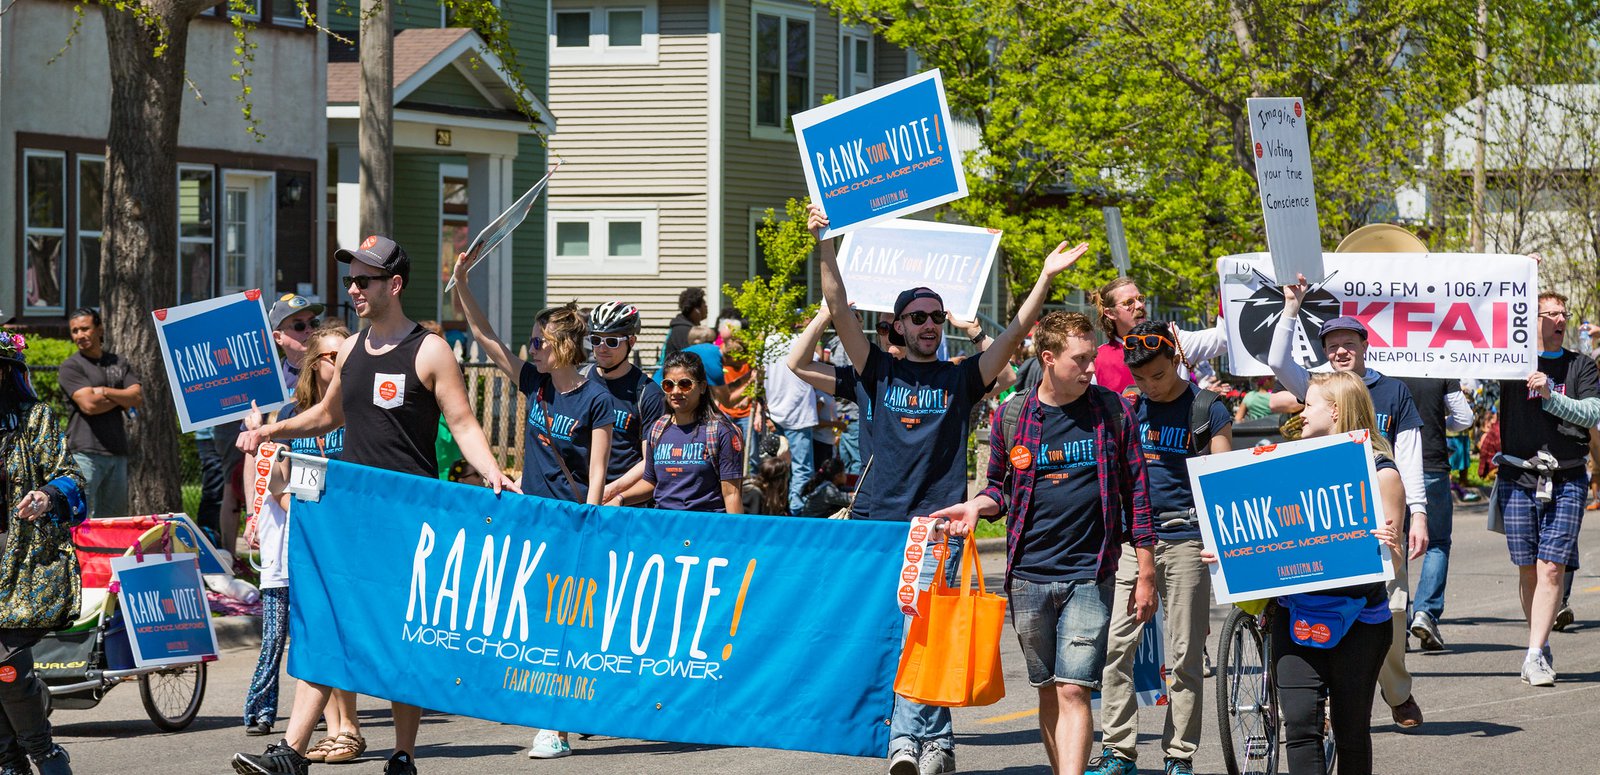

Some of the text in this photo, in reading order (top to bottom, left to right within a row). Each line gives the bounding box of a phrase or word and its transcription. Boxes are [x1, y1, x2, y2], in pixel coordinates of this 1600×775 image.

[1258, 107, 1296, 130] Imagine
[816, 114, 942, 187] RANK YOUR VOTE!
[1267, 139, 1292, 162] Voting
[826, 156, 944, 198] MORE CHOICE. MORE POWER.
[1264, 167, 1302, 186] your true
[1267, 194, 1309, 209] Conscience
[850, 246, 904, 275] RANK
[924, 252, 981, 282] VOTE!
[1236, 262, 1250, 274] 19
[1344, 282, 1526, 297] 90.3 FM 106.7 FM
[1342, 302, 1508, 349] KFAI
[1513, 302, 1528, 349] .ORG
[175, 342, 218, 383] RANK
[226, 329, 270, 370] VOTE!
[1450, 352, 1490, 363] SAINT
[1494, 353, 1528, 364] PAUL
[185, 383, 204, 394] MORE
[231, 372, 249, 382] MORE
[919, 389, 948, 408] VOTE!
[1160, 426, 1191, 449] VOTE!
[1048, 449, 1064, 461] YOUR
[300, 468, 318, 486] 18
[1215, 481, 1368, 546] RANK YOUR VOTE!
[1224, 530, 1369, 558] MORE CHOICE. MORE POWER.
[406, 522, 757, 661] RANK YOUR VOTE!
[128, 591, 164, 624] RANK
[172, 588, 204, 620] VOTE!
[402, 623, 723, 681] MORE CHOICE. MORE POWER.
[34, 661, 86, 669] BURLEY
[503, 666, 597, 701] FAIRVOTEMN.ORG
